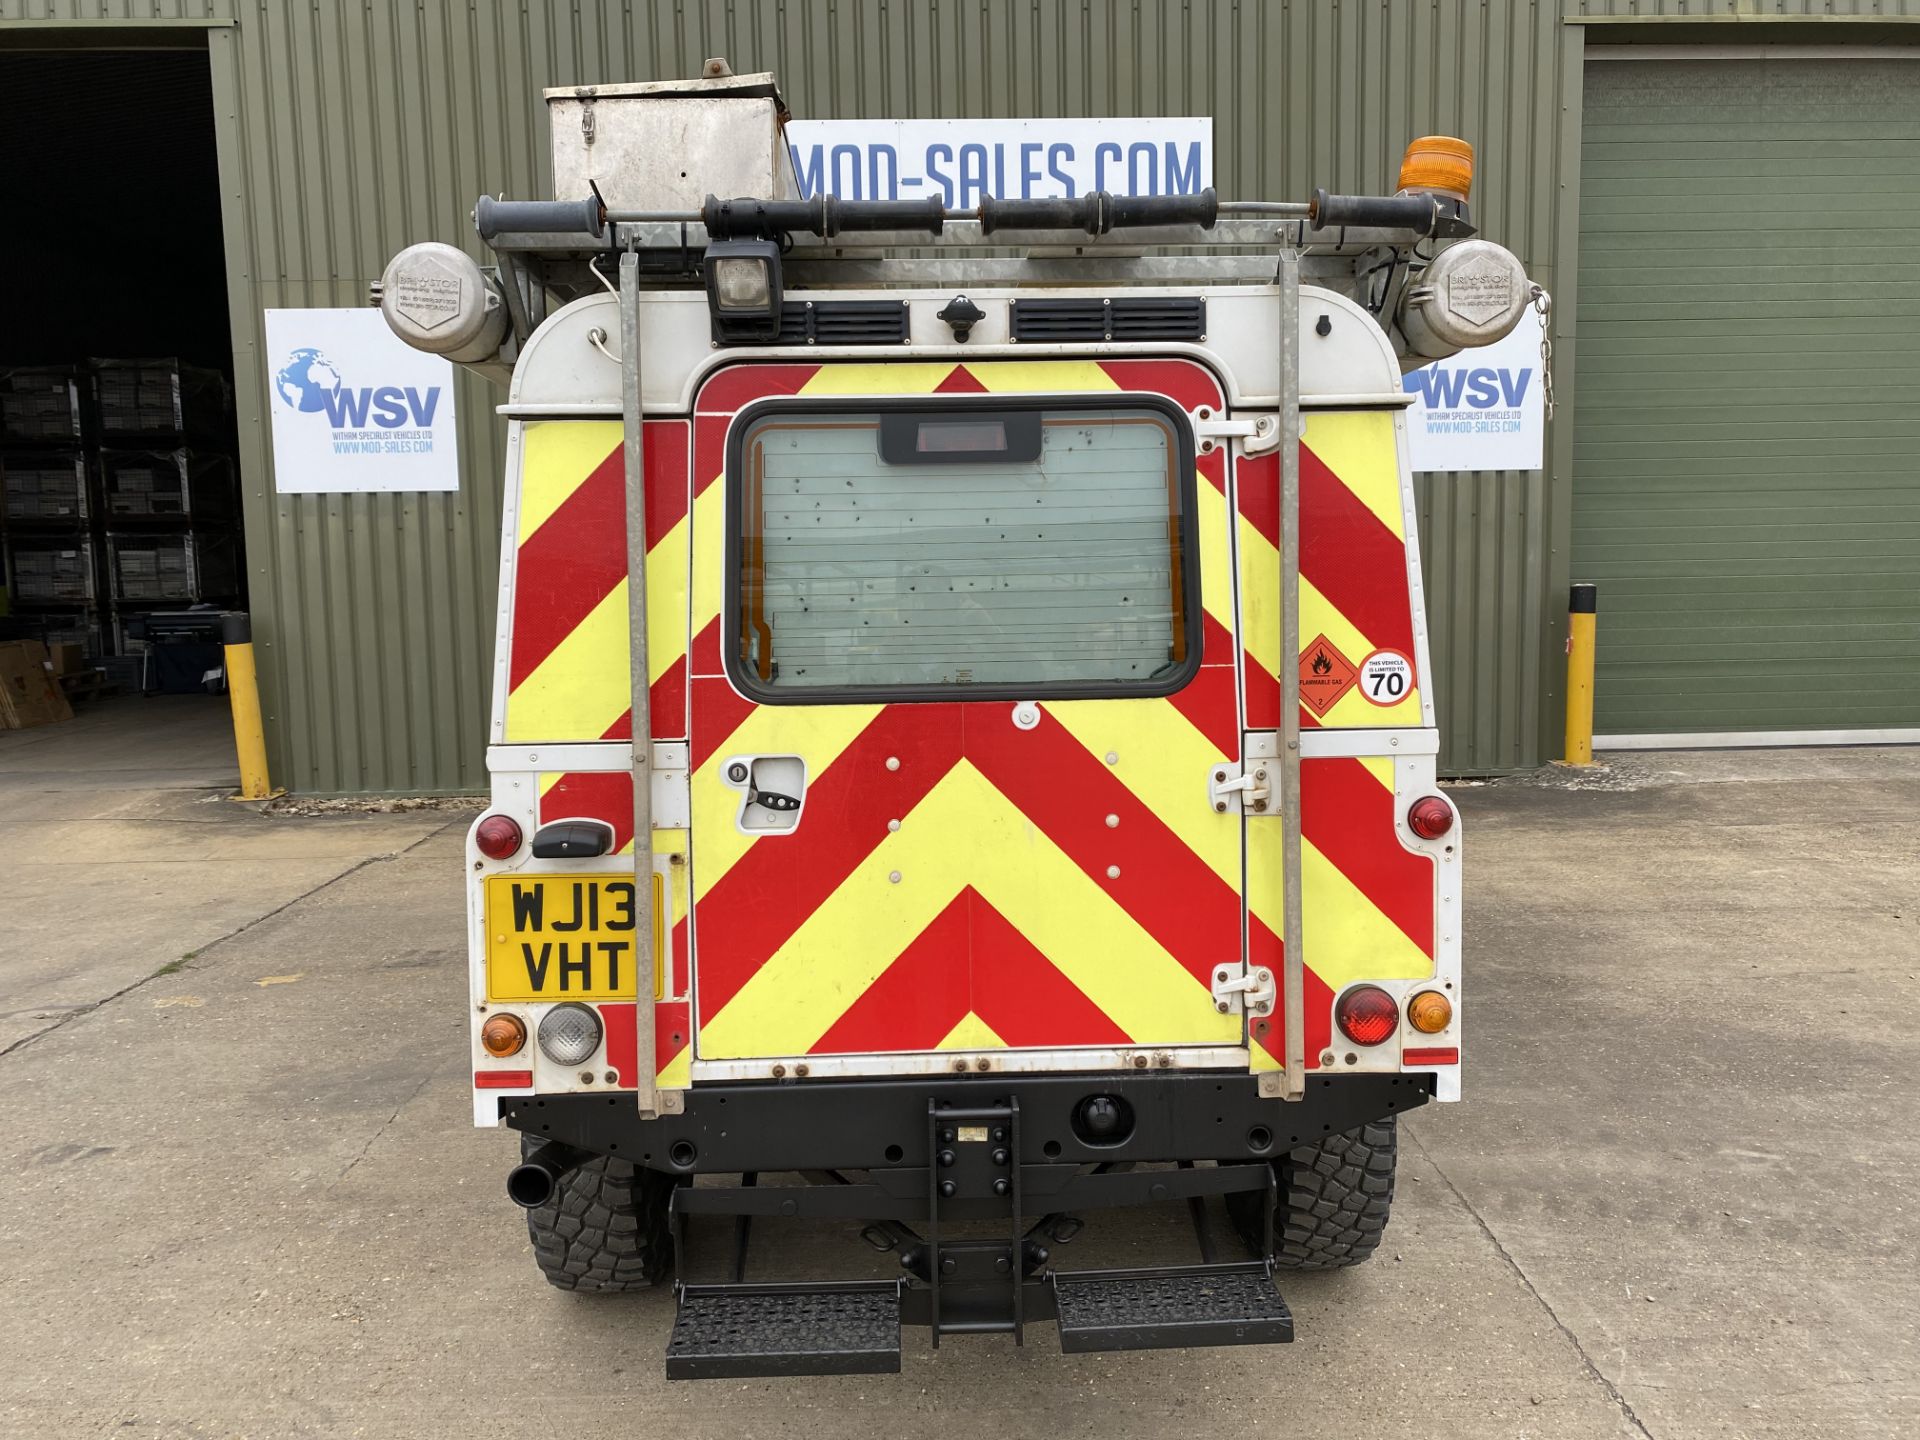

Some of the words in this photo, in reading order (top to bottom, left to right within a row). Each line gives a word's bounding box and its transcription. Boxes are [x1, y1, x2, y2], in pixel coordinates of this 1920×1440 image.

[791, 141, 1201, 208] MOD-SALESCOM
[1418, 368, 1533, 409] WSV
[319, 386, 441, 428] WSV
[1426, 412, 1450, 421] WITHAM
[1451, 411, 1483, 420] SPECIALIST
[1484, 411, 1511, 420] VEHICLES
[1511, 410, 1522, 420] LTD
[332, 431, 358, 441] WITHAM
[358, 431, 392, 440] SPECIALIST
[393, 431, 421, 440] VEHICLES
[422, 430, 433, 440] LTD
[1426, 420, 1521, 434] WWWMOD-SALESCOM
[332, 441, 433, 454] WWWMOD-SALESCOM
[1369, 672, 1404, 696] 70
[1318, 698, 1323, 706] 2
[521, 941, 630, 992] VHT
